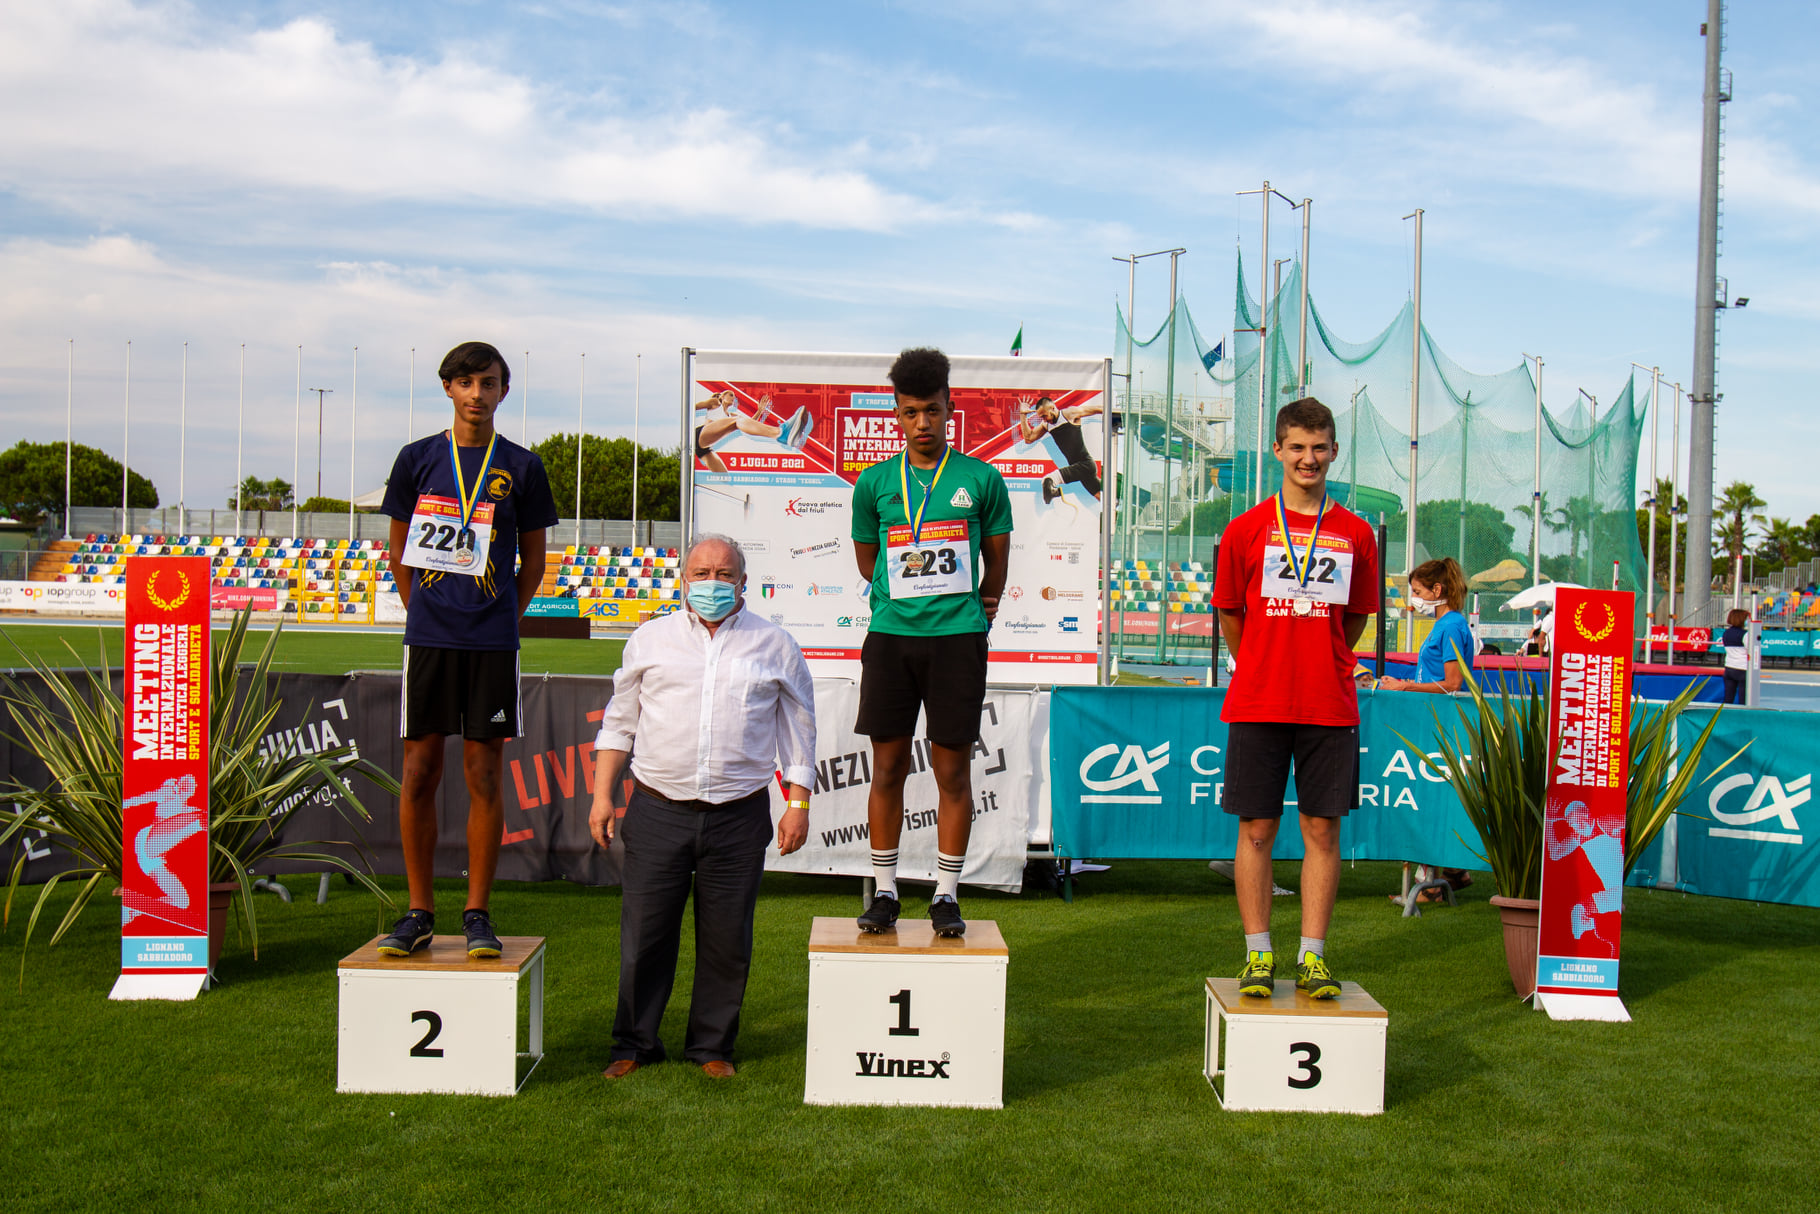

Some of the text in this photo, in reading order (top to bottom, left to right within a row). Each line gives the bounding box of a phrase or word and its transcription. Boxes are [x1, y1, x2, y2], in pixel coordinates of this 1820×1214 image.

[844, 416, 955, 440] MEEG
[730, 458, 804, 468] 3 LUGLIO 2021
[844, 452, 854, 460] DI
[1016, 464, 1044, 474] 20:00
[418, 522, 476, 552] 220
[900, 548, 957, 579] 223
[1278, 553, 1336, 584] 222
[1266, 608, 1288, 617] SAN
[133, 624, 160, 760] MEETING
[160, 624, 176, 760] INTERNAZIONALE
[176, 624, 188, 760] DI ATLETICA LEGGERA
[189, 624, 201, 760] SPORT E SOLIDARIETÀ
[1557, 653, 1586, 786] MEETING
[1582, 654, 1600, 786] INTERNAZIONALE
[1596, 656, 1612, 787] DI ATLETICA LEGGERA
[1609, 656, 1624, 788] SPORT E SOLIDARIETÀ
[137, 953, 192, 962] SABBIADORO
[145, 943, 184, 952] LIGNANO
[1552, 972, 1605, 984] SABBIADORO
[1561, 963, 1598, 973] LIGNANO
[889, 990, 920, 1036] 1
[410, 1010, 444, 1058] 2
[1288, 1042, 1322, 1090] 3
